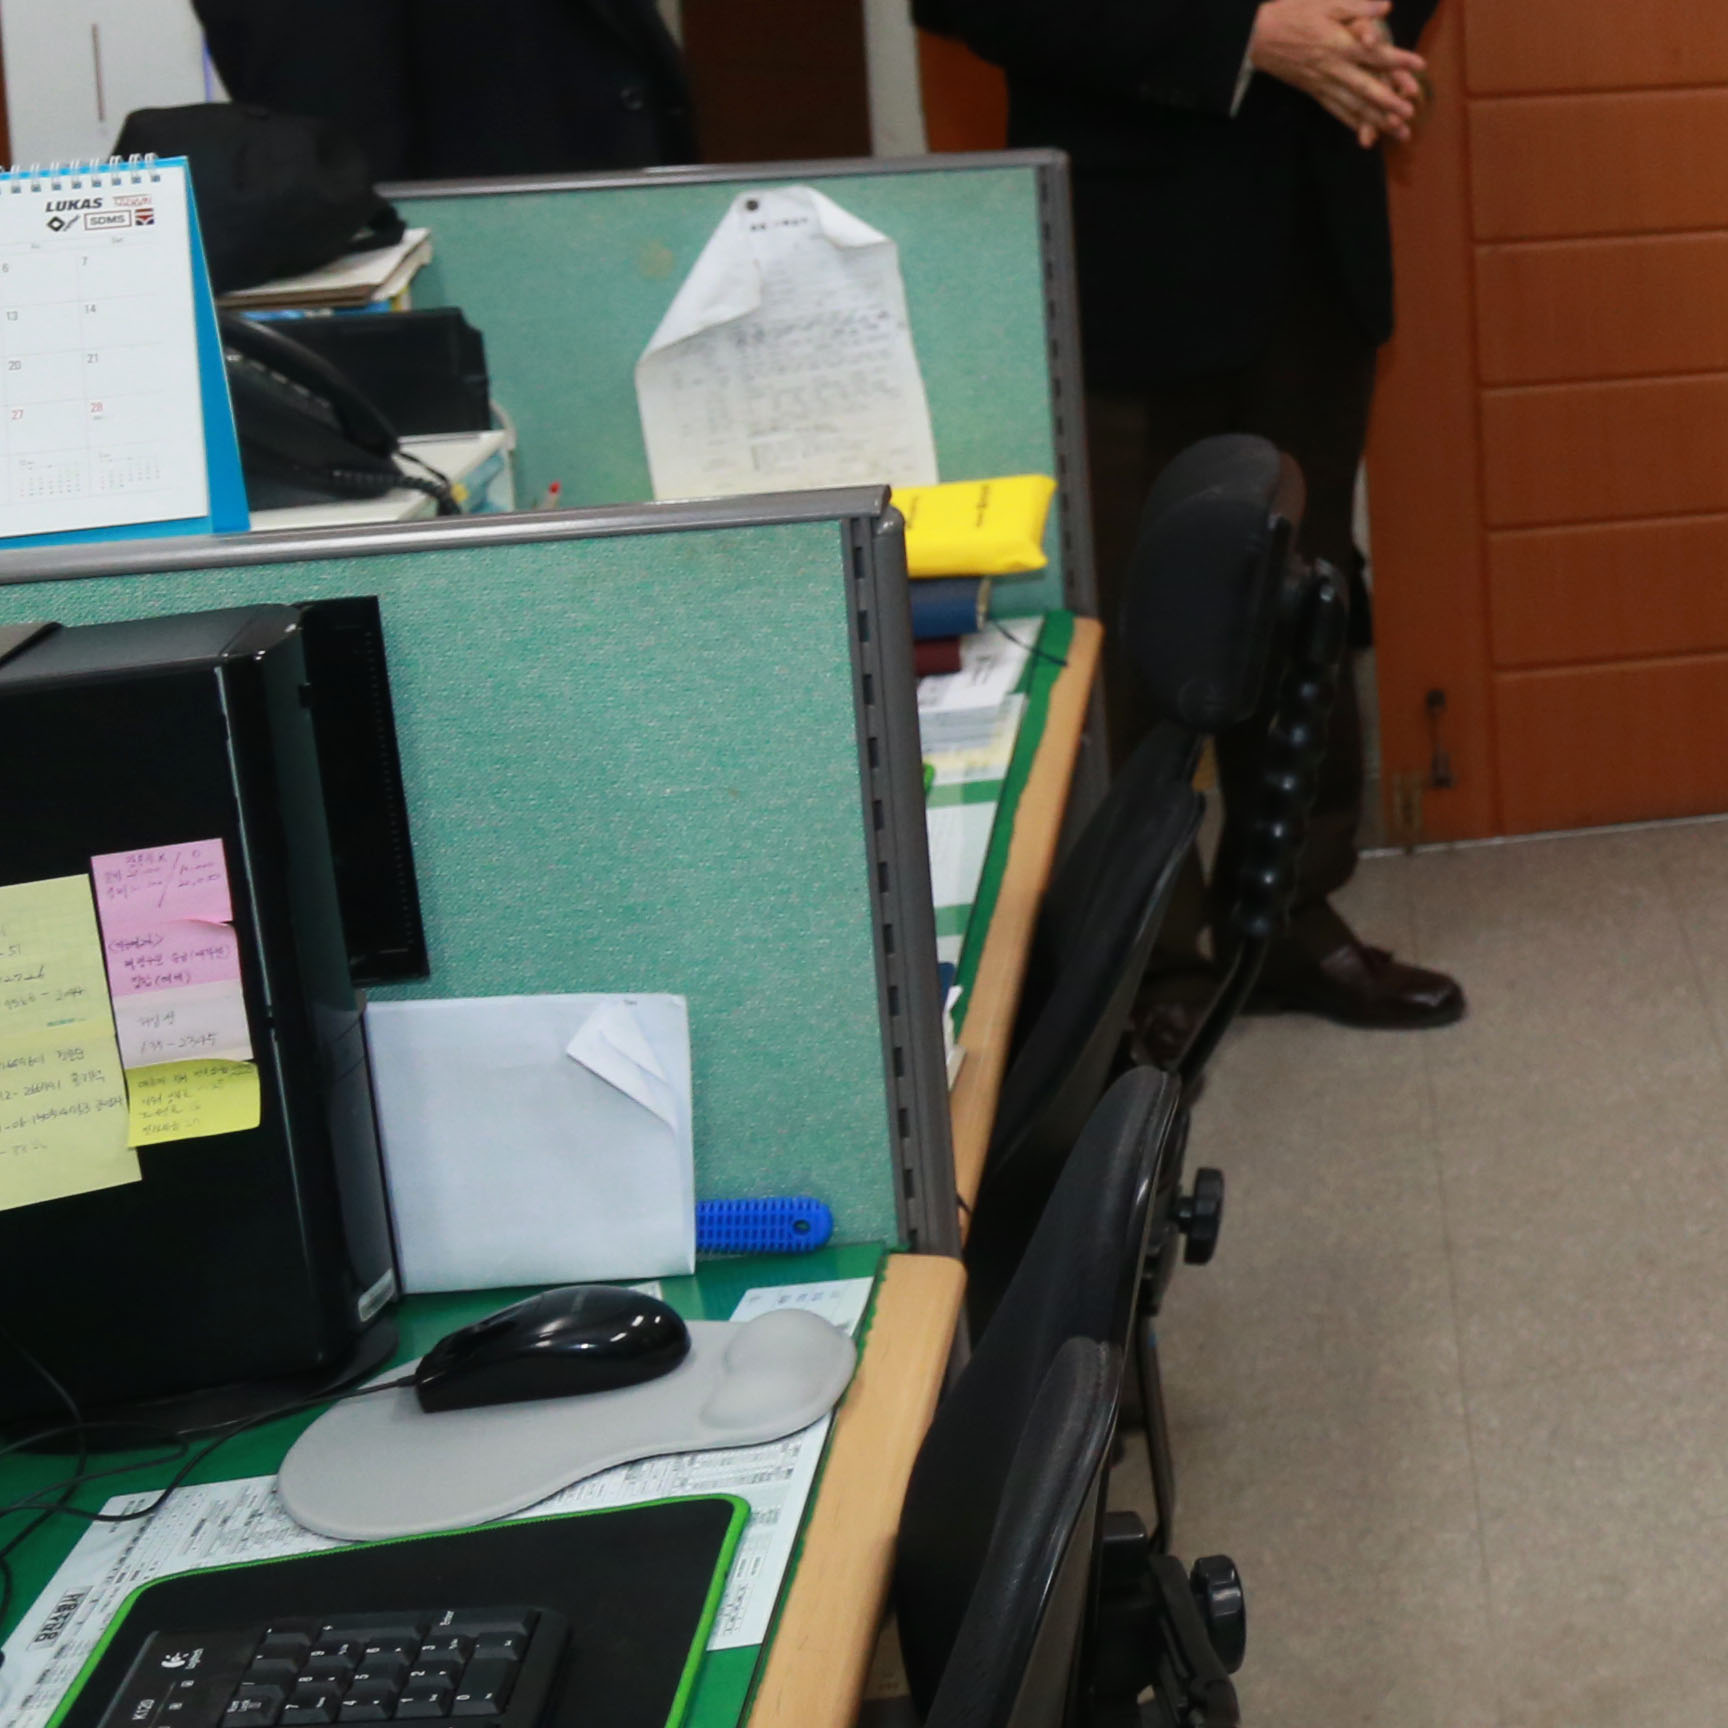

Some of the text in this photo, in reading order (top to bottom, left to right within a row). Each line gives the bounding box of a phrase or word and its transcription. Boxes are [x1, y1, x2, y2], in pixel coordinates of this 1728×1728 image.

[45, 197, 103, 213] LUKAS
[34, 1592, 84, 1643] 당진소방서
[132, 1699, 155, 1721] K120
